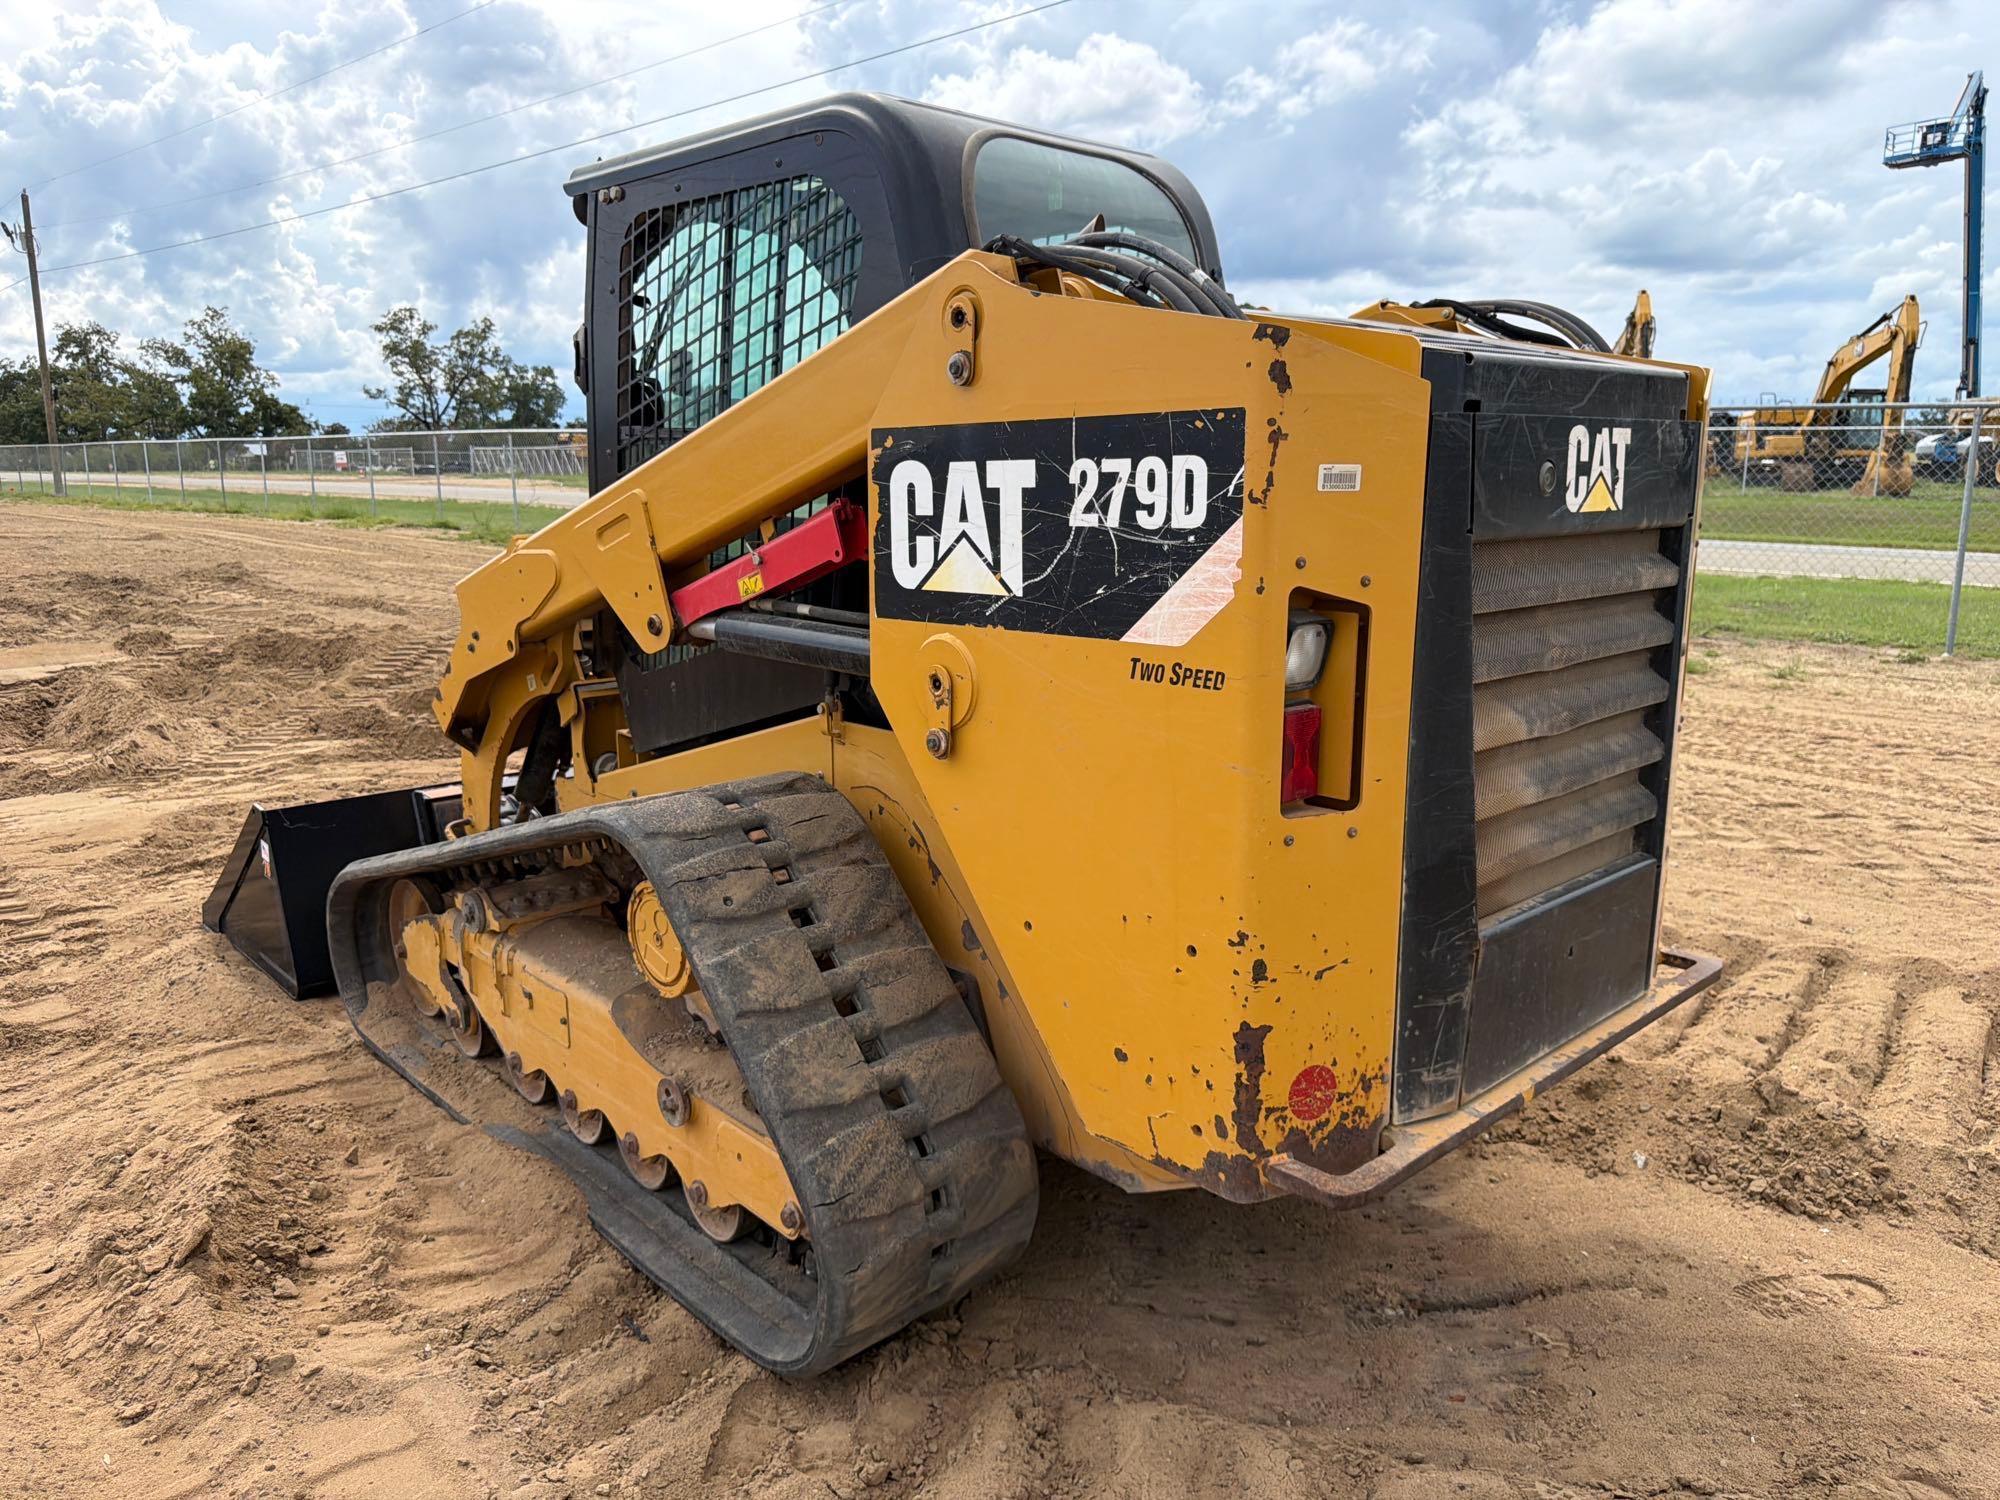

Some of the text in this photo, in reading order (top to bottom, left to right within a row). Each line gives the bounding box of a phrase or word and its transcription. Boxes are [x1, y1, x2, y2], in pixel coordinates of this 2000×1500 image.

[889, 454, 1208, 597] CAT 279D
[1565, 424, 1631, 513] CAT
